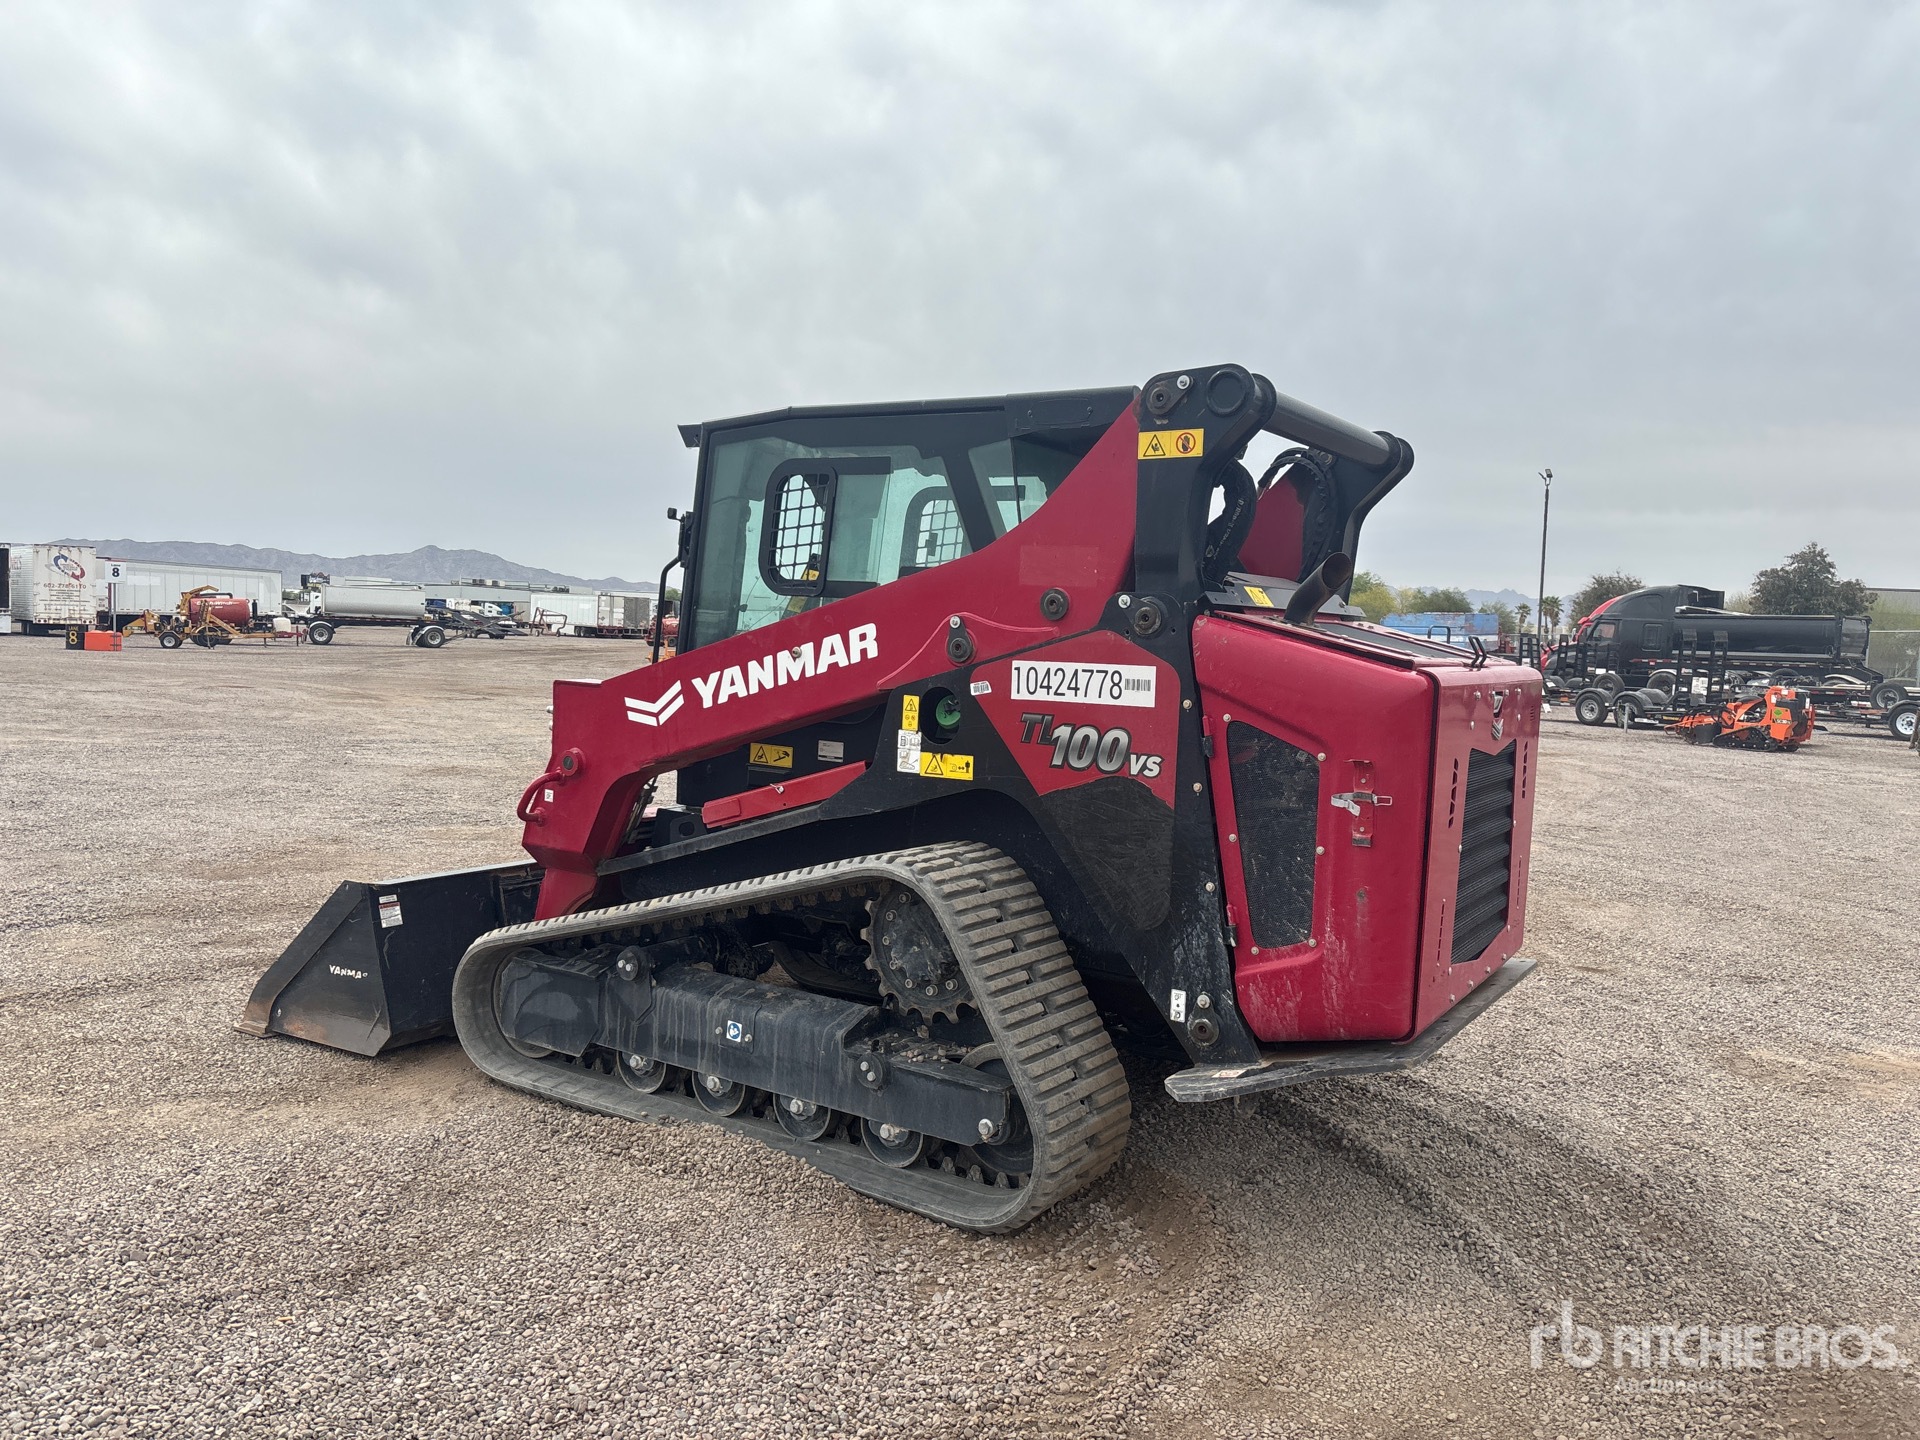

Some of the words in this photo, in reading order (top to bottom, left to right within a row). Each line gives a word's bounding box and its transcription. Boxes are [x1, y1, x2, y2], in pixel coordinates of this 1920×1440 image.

[112, 567, 120, 578] 8
[69, 631, 78, 645] 8
[691, 622, 879, 709] YANMAR
[1013, 666, 1123, 700] 10424778
